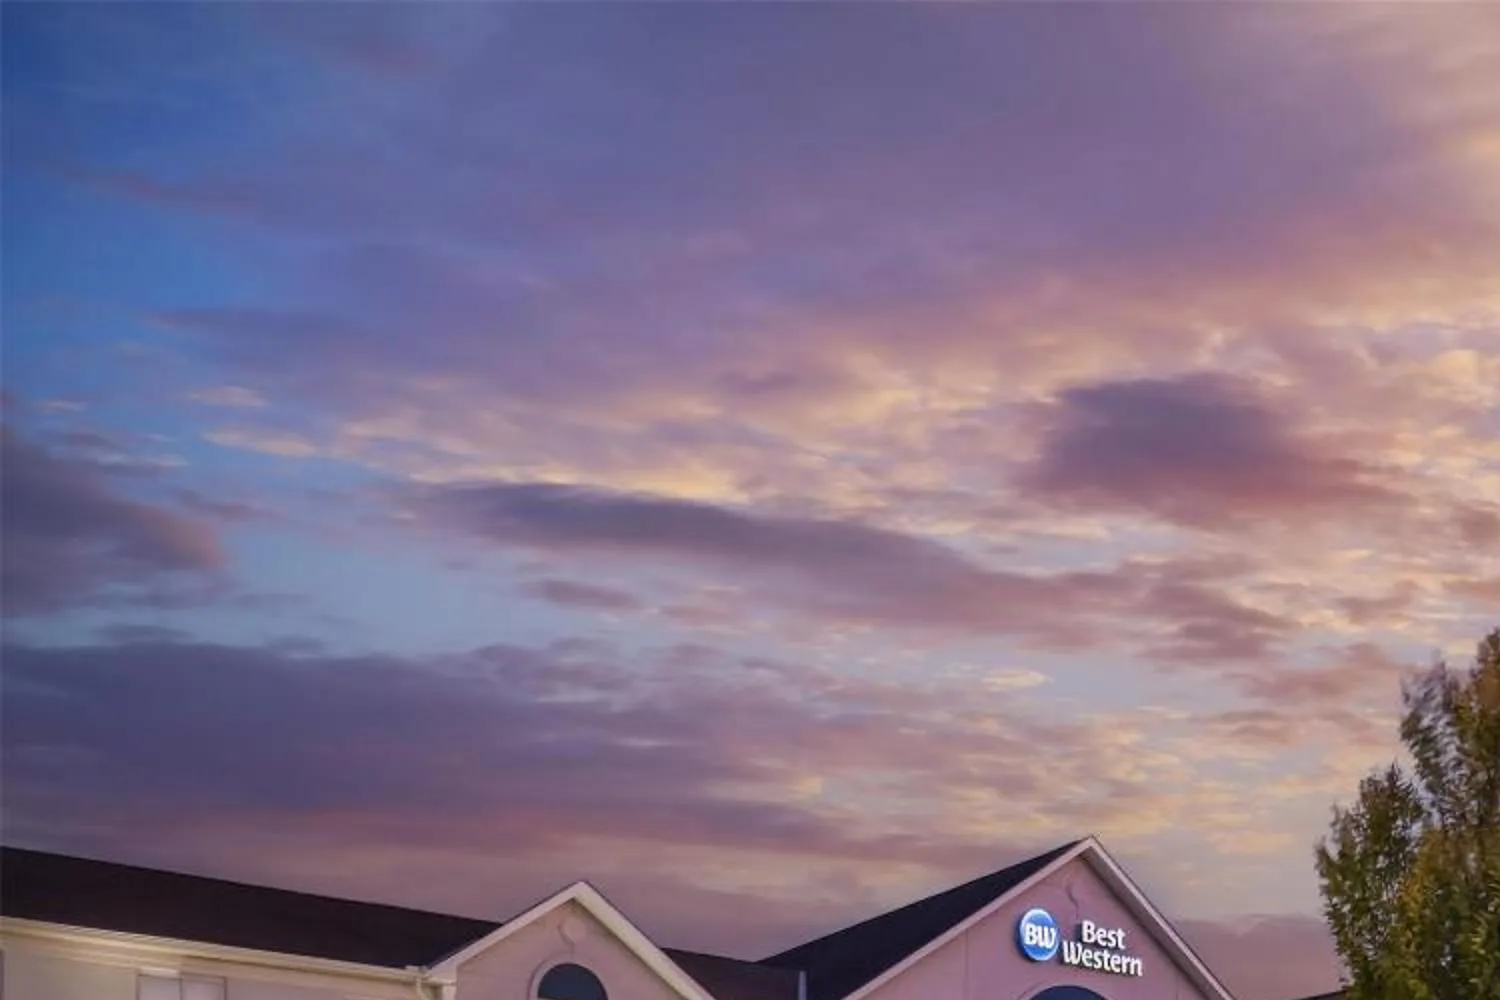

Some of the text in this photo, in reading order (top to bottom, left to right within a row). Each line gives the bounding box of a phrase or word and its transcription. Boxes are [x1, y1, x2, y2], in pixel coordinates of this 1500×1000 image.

[1024, 923, 1057, 949] BW
[1082, 920, 1126, 949] Best
[1062, 941, 1143, 976] Western
